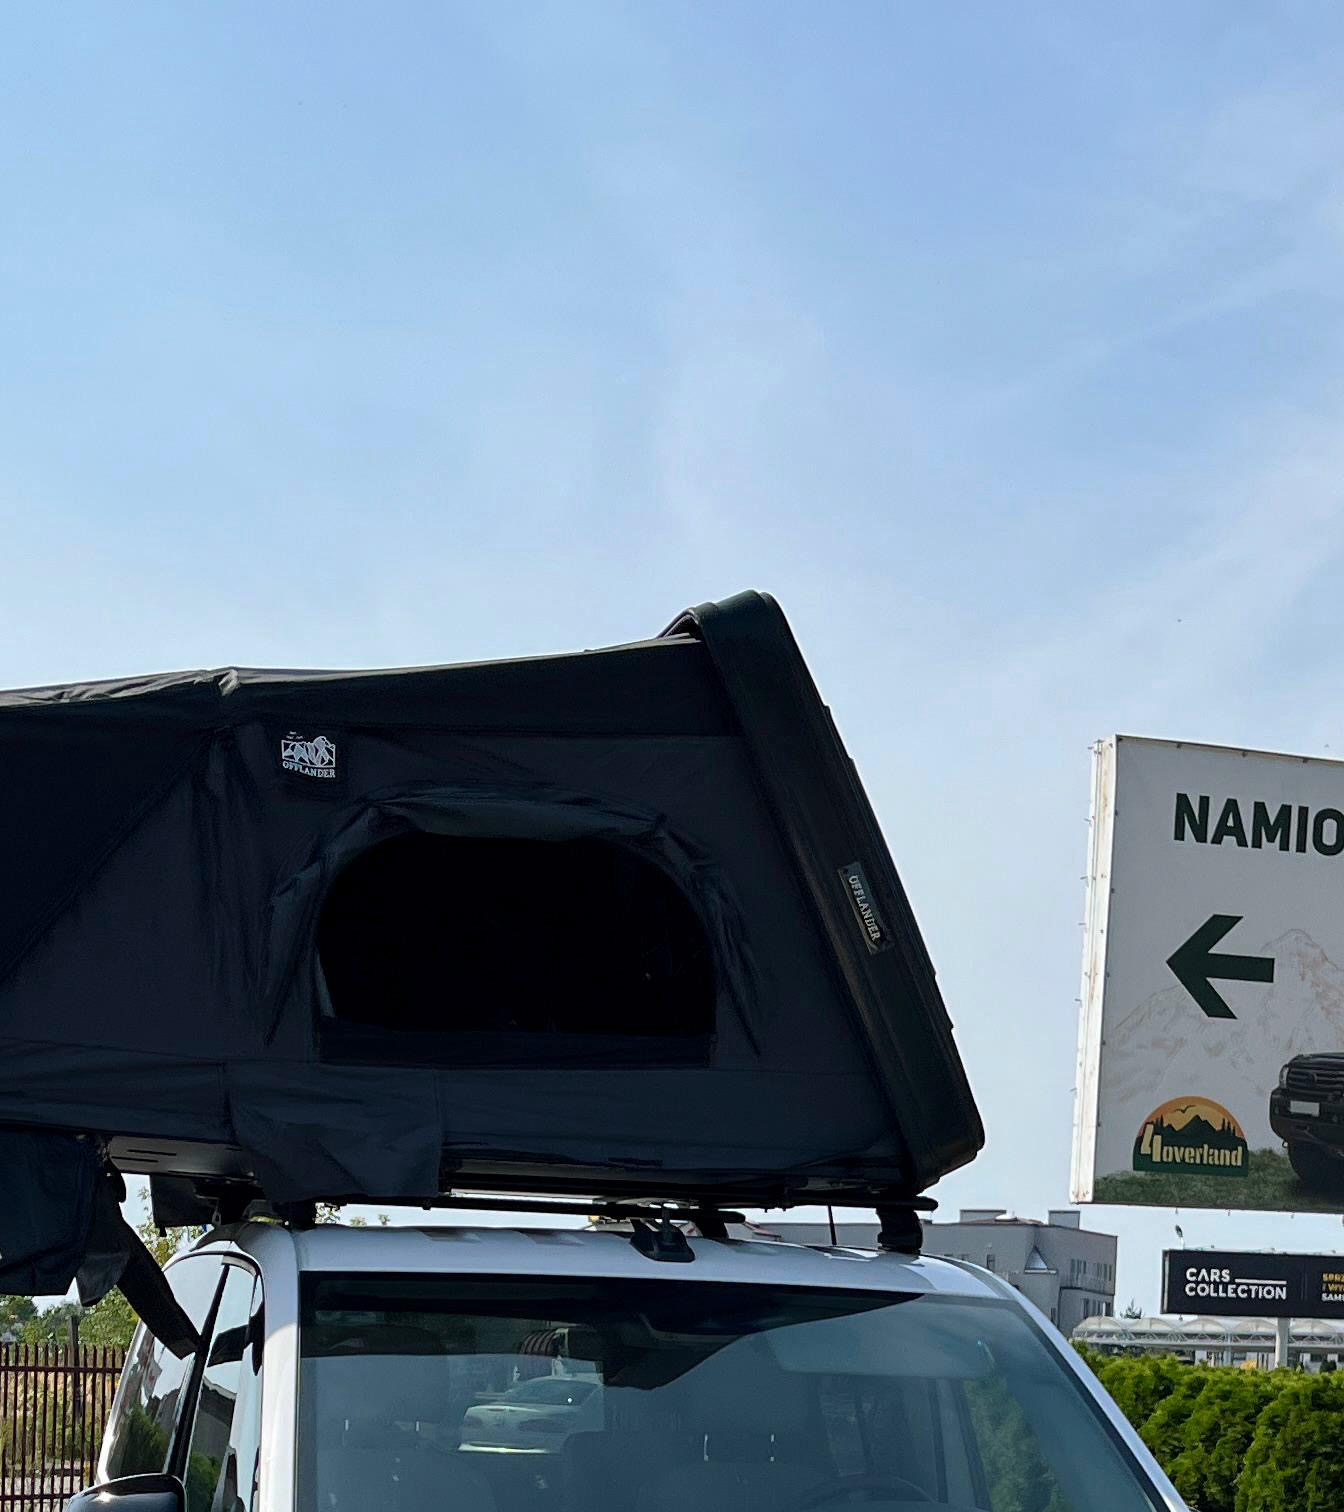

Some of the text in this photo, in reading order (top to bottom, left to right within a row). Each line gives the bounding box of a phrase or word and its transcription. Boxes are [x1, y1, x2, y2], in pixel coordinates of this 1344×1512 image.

[282, 760, 336, 779] OFFLANDER
[848, 875, 882, 943] OFFLANDER
[1185, 1267, 1230, 1282] CARS
[1184, 1282, 1287, 1300] COLLECTION
